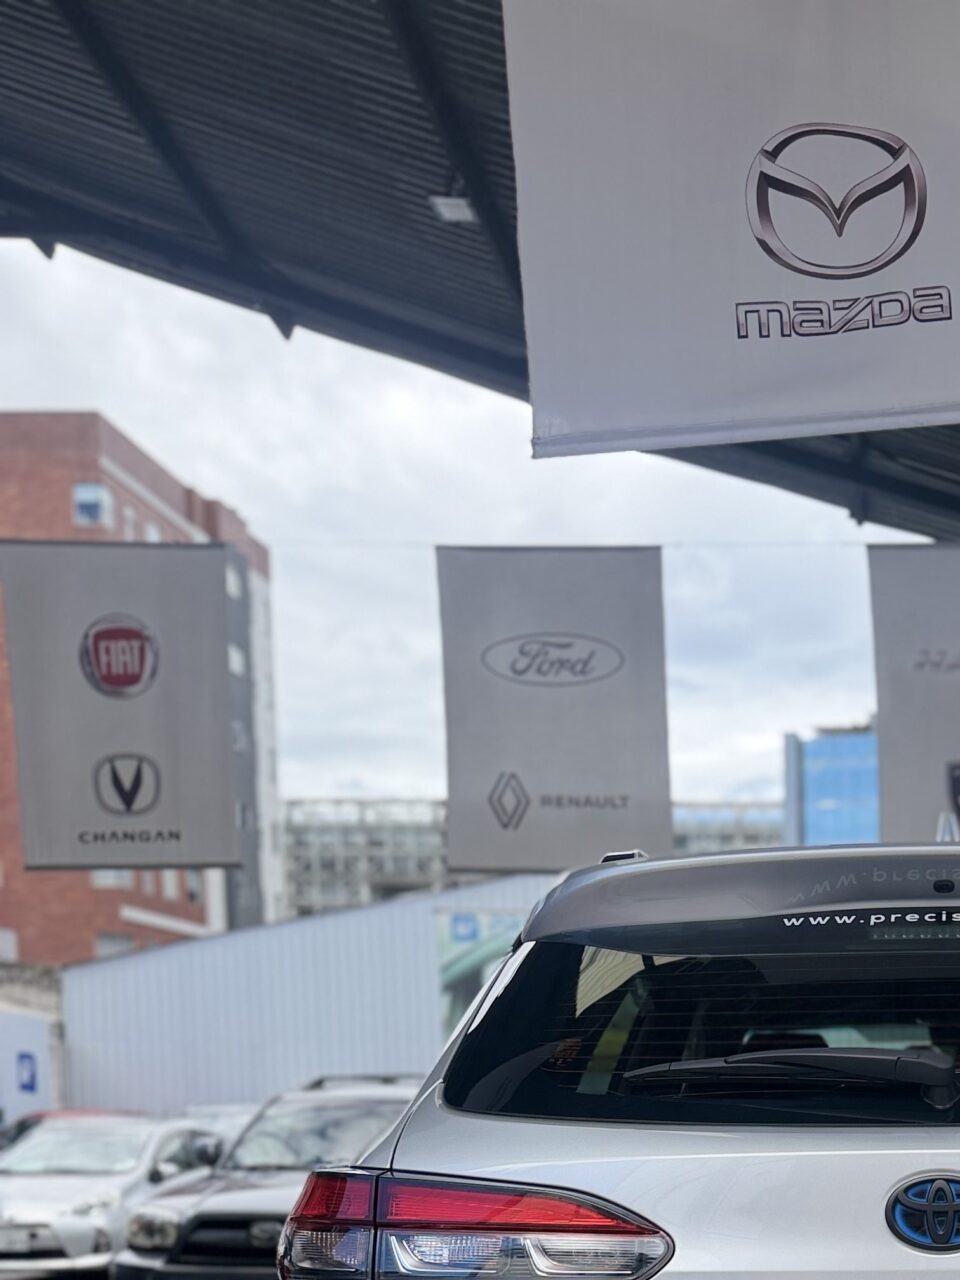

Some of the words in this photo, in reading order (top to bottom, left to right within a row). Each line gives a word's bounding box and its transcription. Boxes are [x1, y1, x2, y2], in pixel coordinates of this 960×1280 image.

[98, 638, 143, 676] FIAT
[510, 639, 596, 677] Ford
[539, 793, 630, 809] RENAULT
[78, 829, 182, 844] CHANGAN
